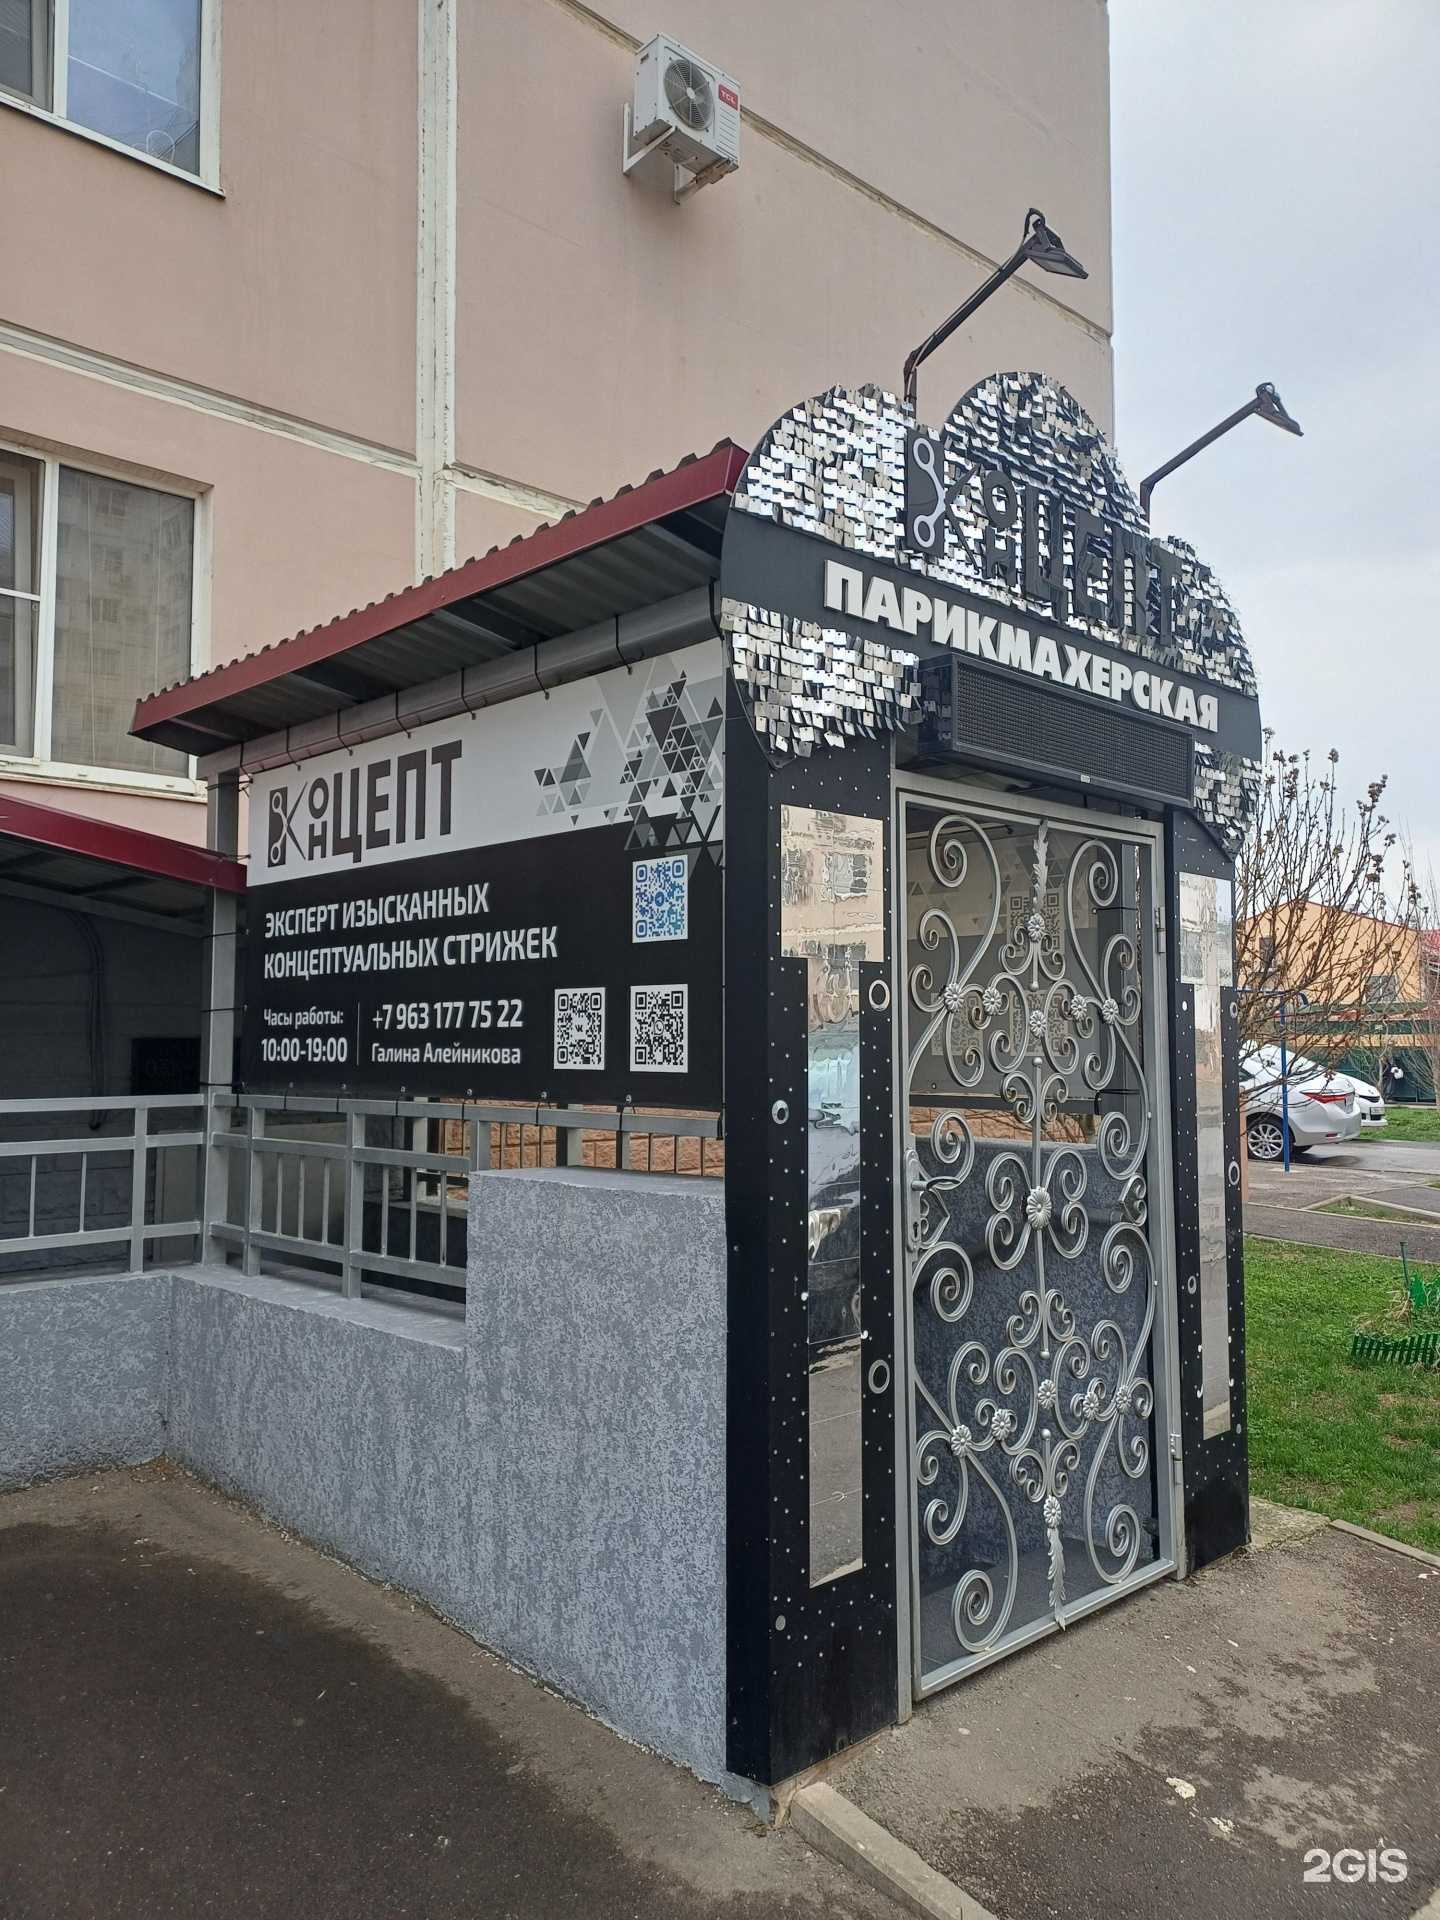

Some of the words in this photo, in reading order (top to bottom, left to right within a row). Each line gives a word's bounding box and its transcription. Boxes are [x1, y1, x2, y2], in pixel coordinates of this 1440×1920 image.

[719, 89, 738, 106] TCL
[824, 559, 1219, 733] ПАРИКМАХЕРСКАЯ
[264, 903, 339, 938] ЭКСПЕРТ
[342, 882, 490, 929] ИЗЫСКАННЫХ
[264, 937, 438, 981] КОНЦЕПТУАЛЬНЫХ
[443, 926, 558, 966] СТРИЖЕК
[264, 1008, 293, 1026] Часы
[295, 1006, 344, 1029] работы:
[372, 1004, 393, 1030] +7
[396, 1002, 429, 1030] 963
[433, 1001, 465, 1029] 177
[468, 1001, 492, 1029] 75
[496, 999, 524, 1028] 22
[261, 1037, 348, 1062] 10:00-19:00
[371, 1042, 420, 1063] Галина
[423, 1042, 521, 1064] Алейникова
